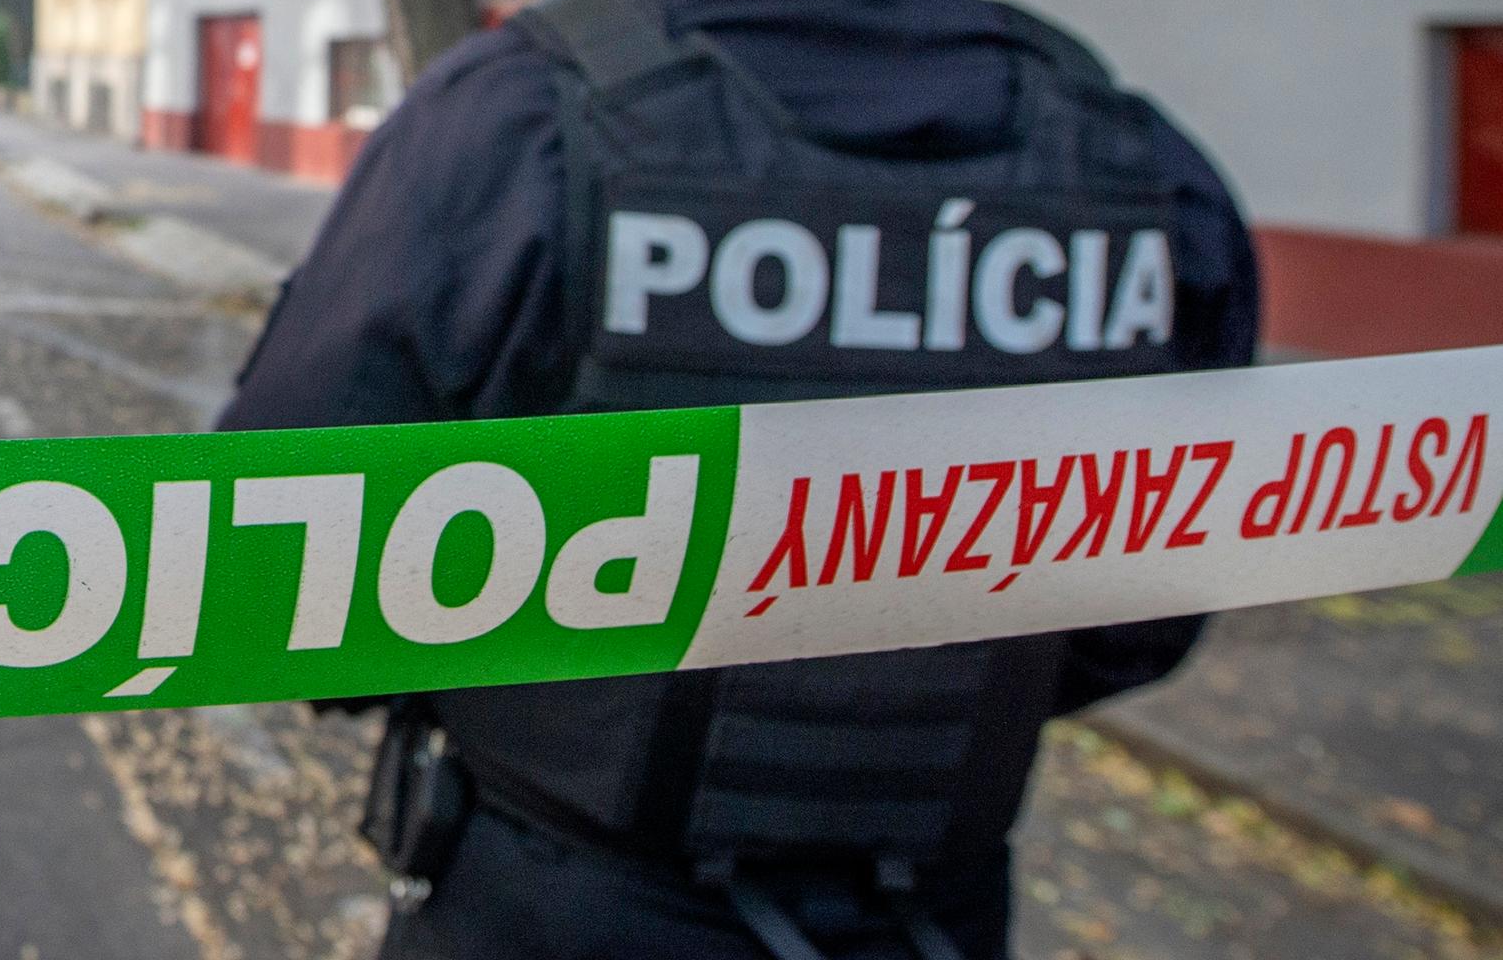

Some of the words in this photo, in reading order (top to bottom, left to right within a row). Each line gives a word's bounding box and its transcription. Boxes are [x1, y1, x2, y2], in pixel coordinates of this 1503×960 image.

[604, 198, 1176, 354] POLÍCIA
[744, 440, 1235, 617] ZAKÁZANÝ
[1238, 414, 1489, 542] VSTUP
